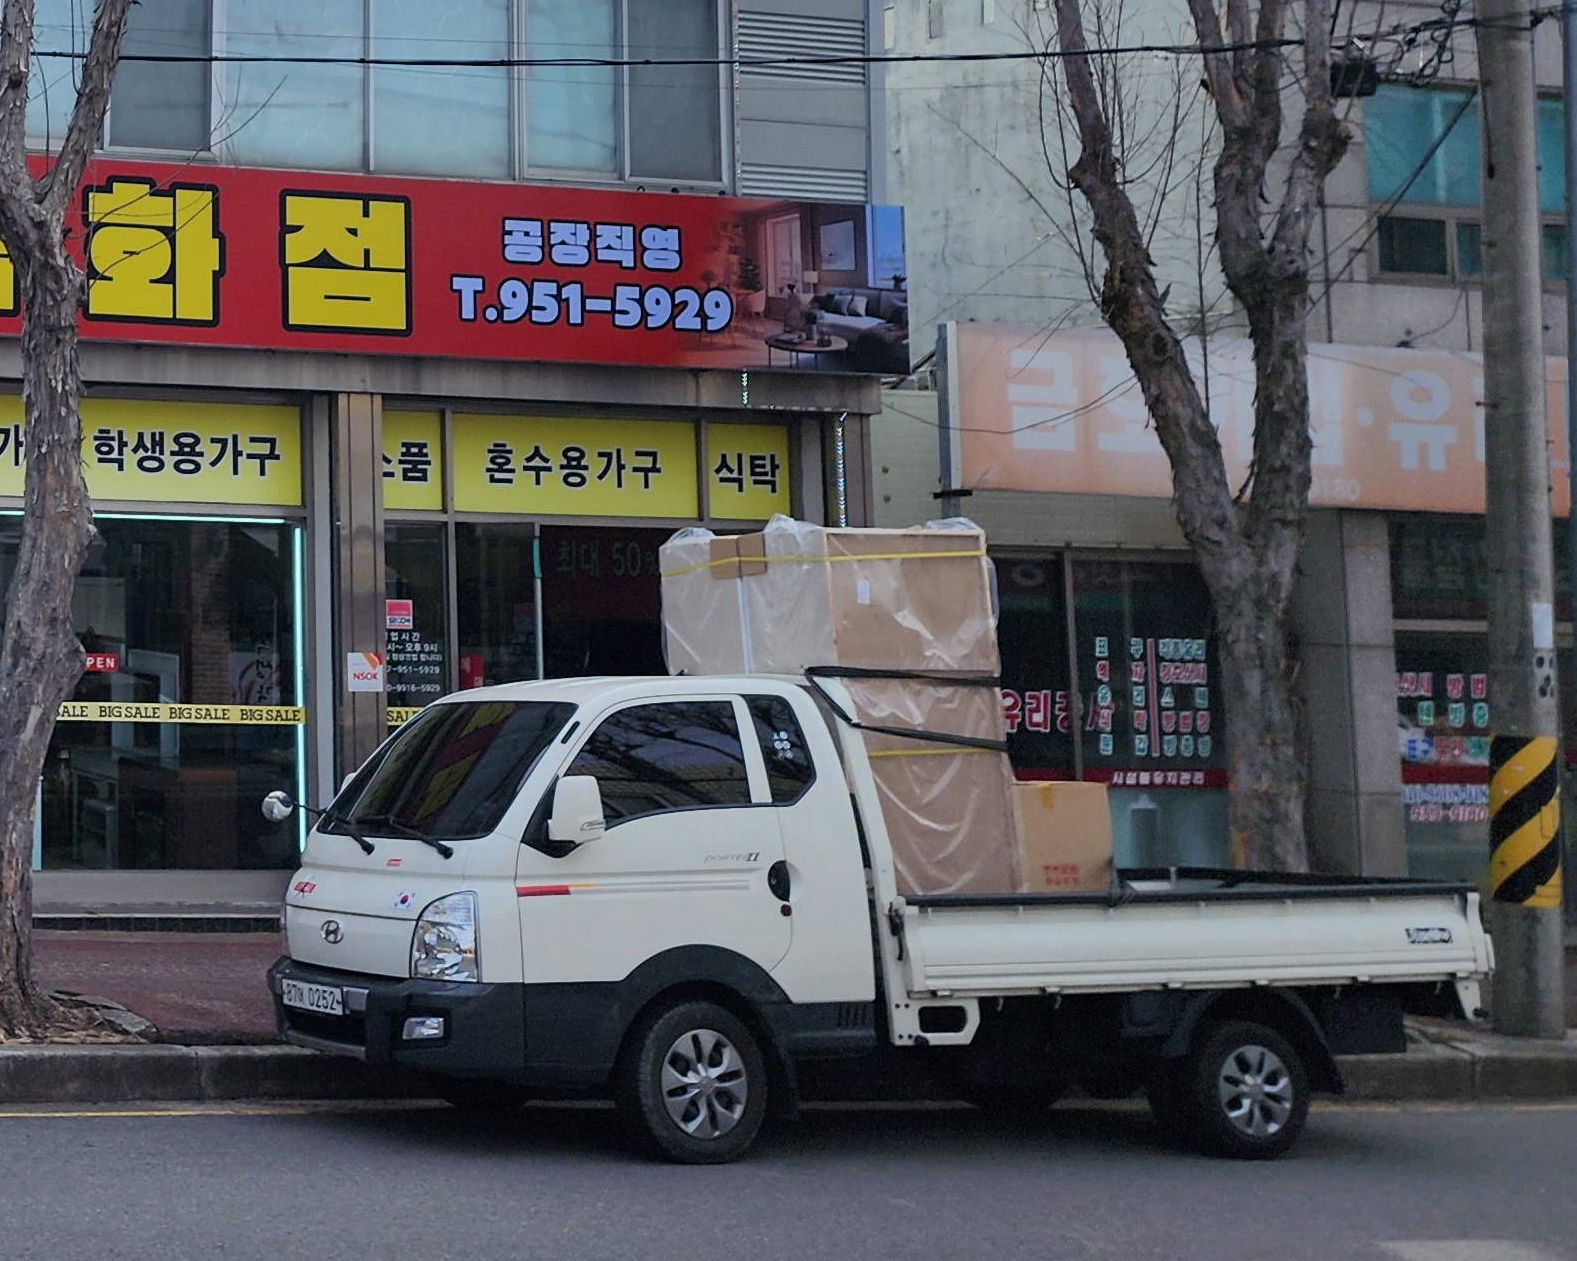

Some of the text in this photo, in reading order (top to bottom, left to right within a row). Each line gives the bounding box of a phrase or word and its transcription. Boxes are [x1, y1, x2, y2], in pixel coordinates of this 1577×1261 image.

[502, 217, 682, 271] 공장직영
[450, 274, 733, 332] T.951-5929
[92, 428, 281, 477] 학생용가구
[484, 442, 662, 490] 혼수용가구
[713, 452, 780, 494] 식탁
[85, 656, 116, 669] PEN
[352, 672, 379, 681] NSOK
[98, 706, 122, 718] BIG
[124, 706, 161, 719] SALE
[168, 708, 192, 719] BIG
[194, 708, 231, 720] SALE
[239, 709, 263, 721] BIG
[265, 710, 301, 721] SALE
[308, 987, 337, 1011] 0252
